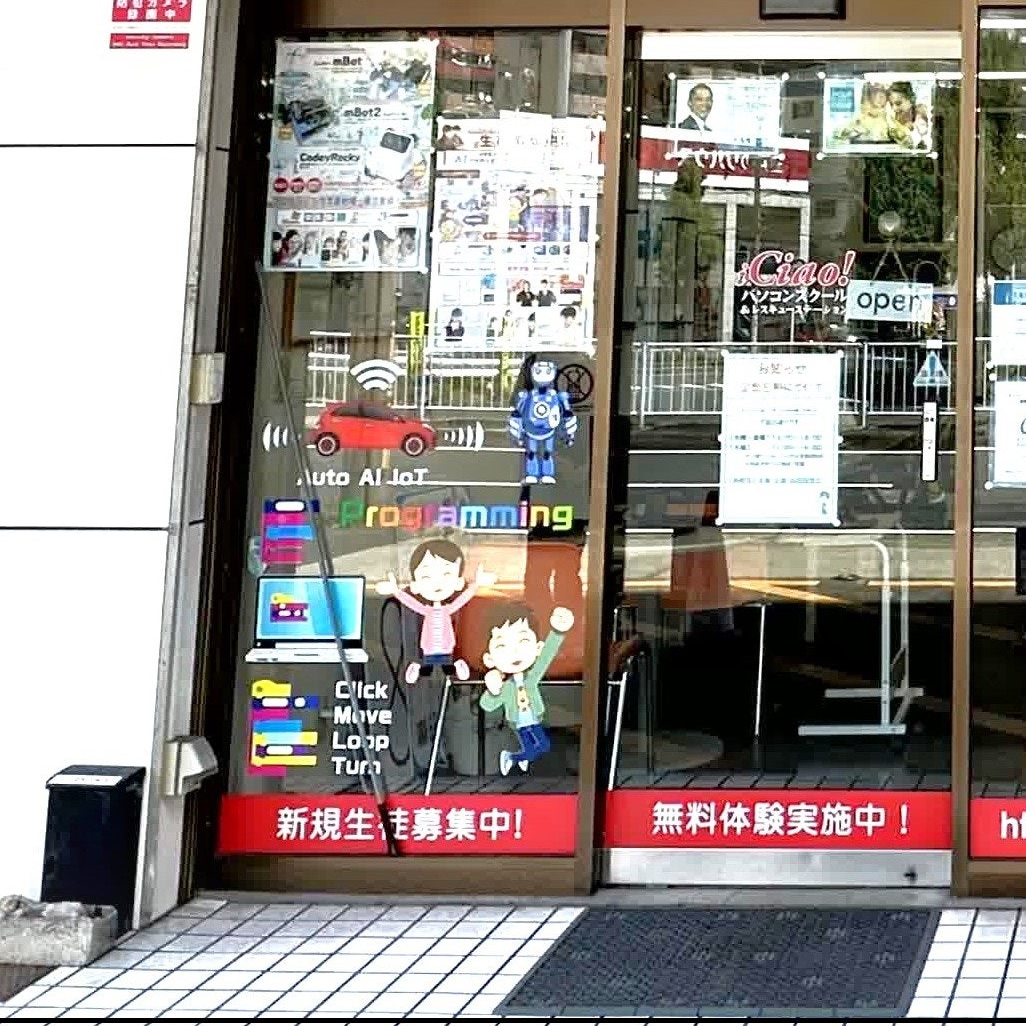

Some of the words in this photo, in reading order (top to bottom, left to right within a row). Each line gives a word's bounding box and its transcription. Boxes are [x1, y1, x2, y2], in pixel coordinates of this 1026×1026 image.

[343, 107, 382, 117] mBot2
[741, 289, 848, 305] パソコンスクール
[359, 468, 382, 486] AI
[338, 499, 574, 531] Programming
[335, 680, 389, 699] Click
[333, 705, 392, 725] Move
[332, 731, 390, 752] Loop
[331, 756, 381, 775] Turn
[276, 807, 523, 841] 新規生徒募集中!
